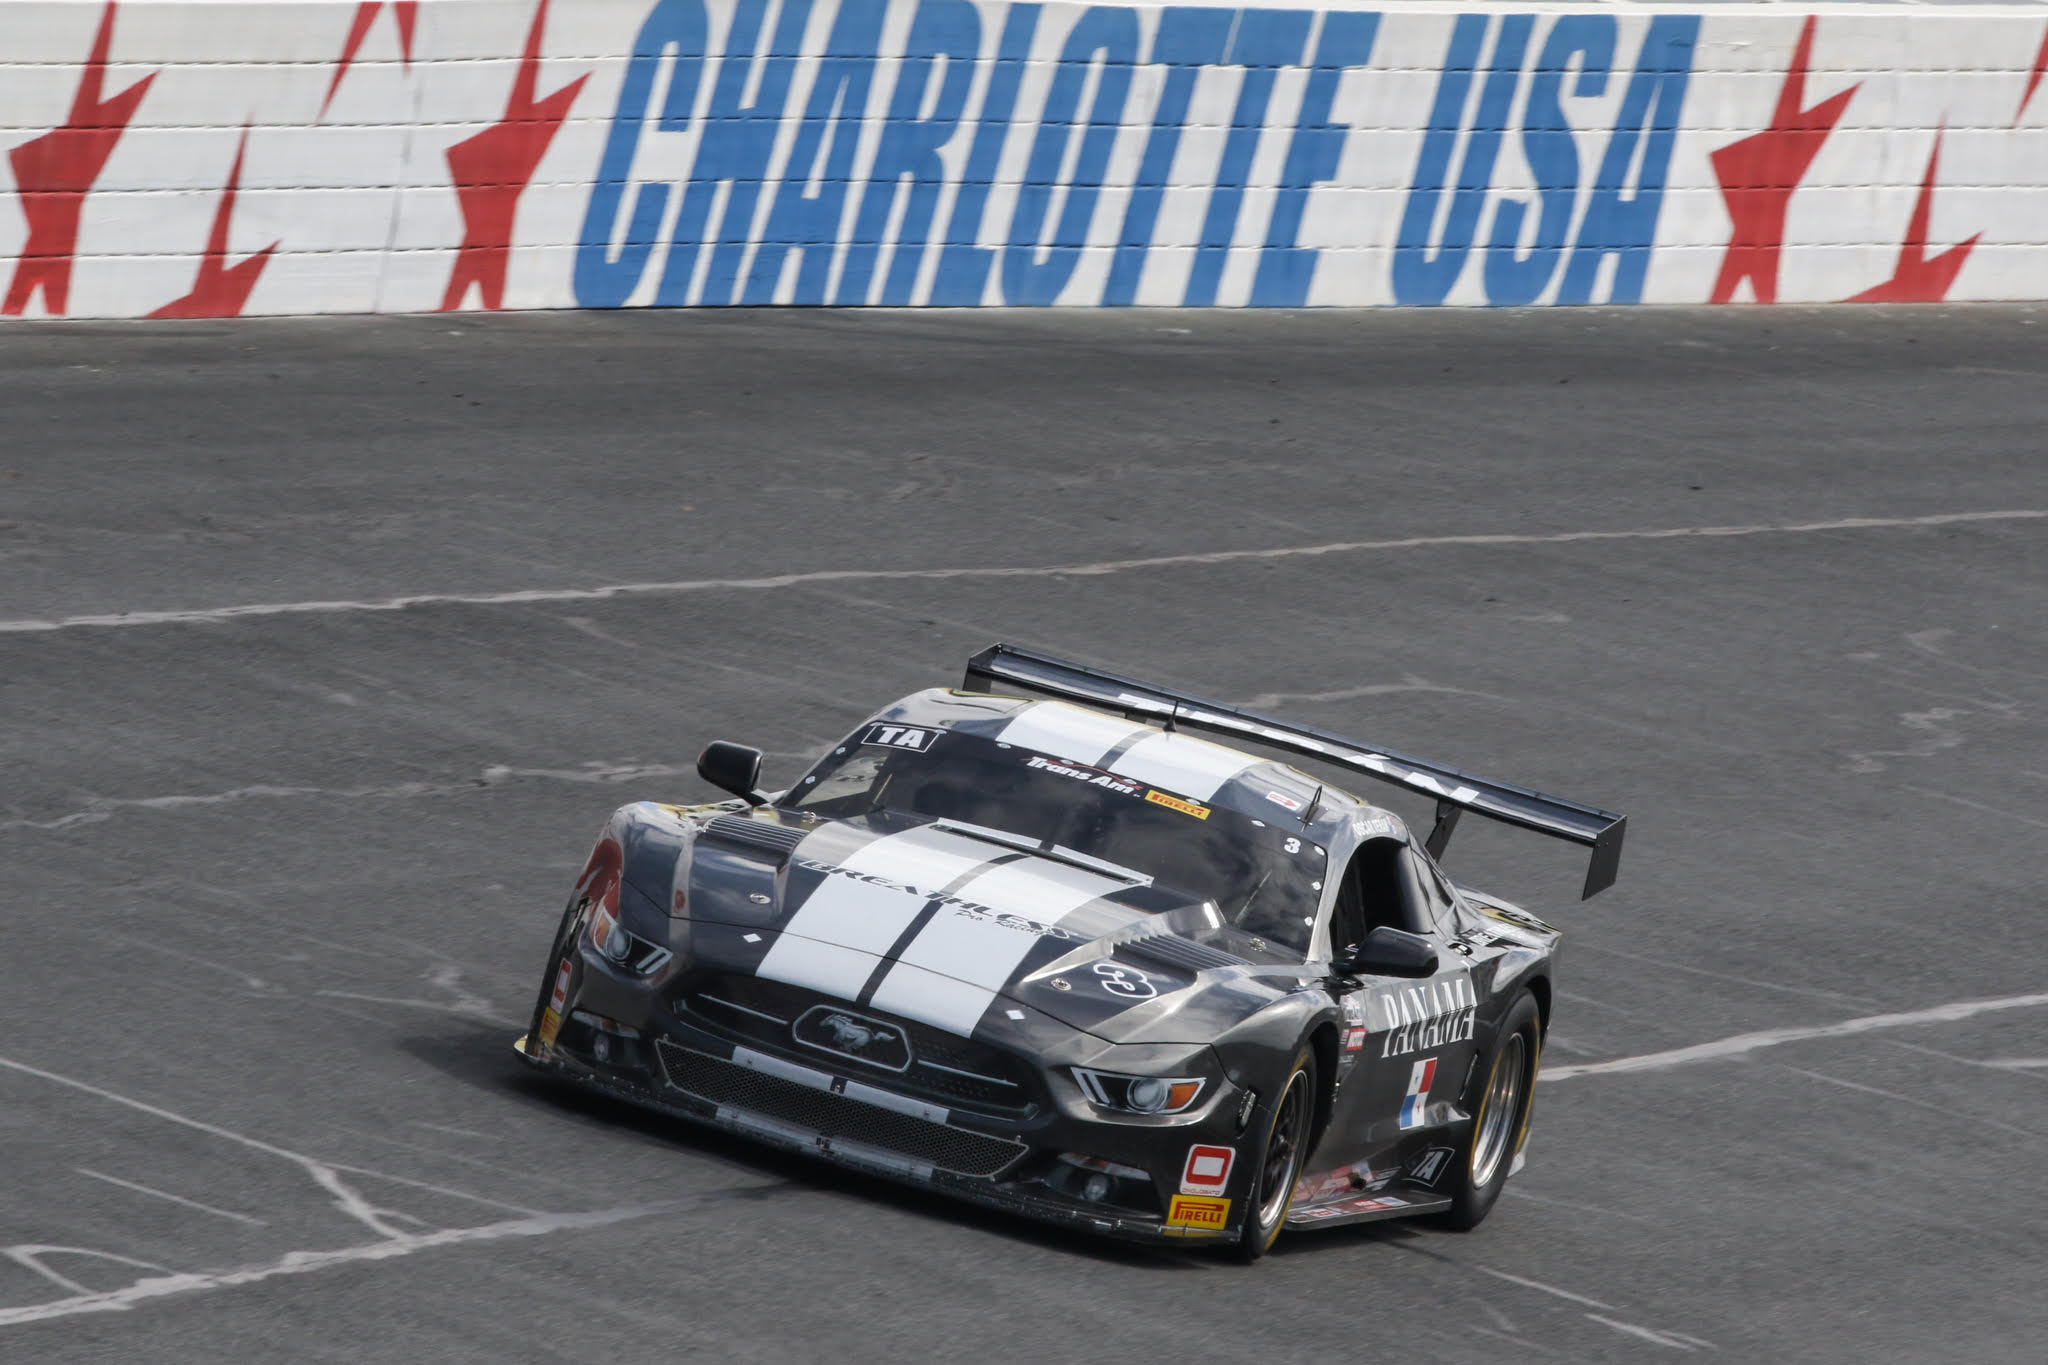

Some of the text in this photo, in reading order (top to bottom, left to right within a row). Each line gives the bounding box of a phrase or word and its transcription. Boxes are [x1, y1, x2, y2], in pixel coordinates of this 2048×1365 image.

[573, 0, 1703, 309] CHARLOTTE USA
[876, 726, 926, 748] TA
[1026, 755, 1136, 795] Trans Am
[1150, 792, 1206, 817] PIRELLI
[1283, 836, 1301, 854] 3
[799, 859, 1078, 939] BREATHLESS
[954, 908, 984, 921] Pro
[1093, 963, 1158, 998] 3
[1381, 978, 1478, 1059] PANAMA
[1410, 1151, 1445, 1180] TA
[1173, 1201, 1225, 1223] PIRELLI
